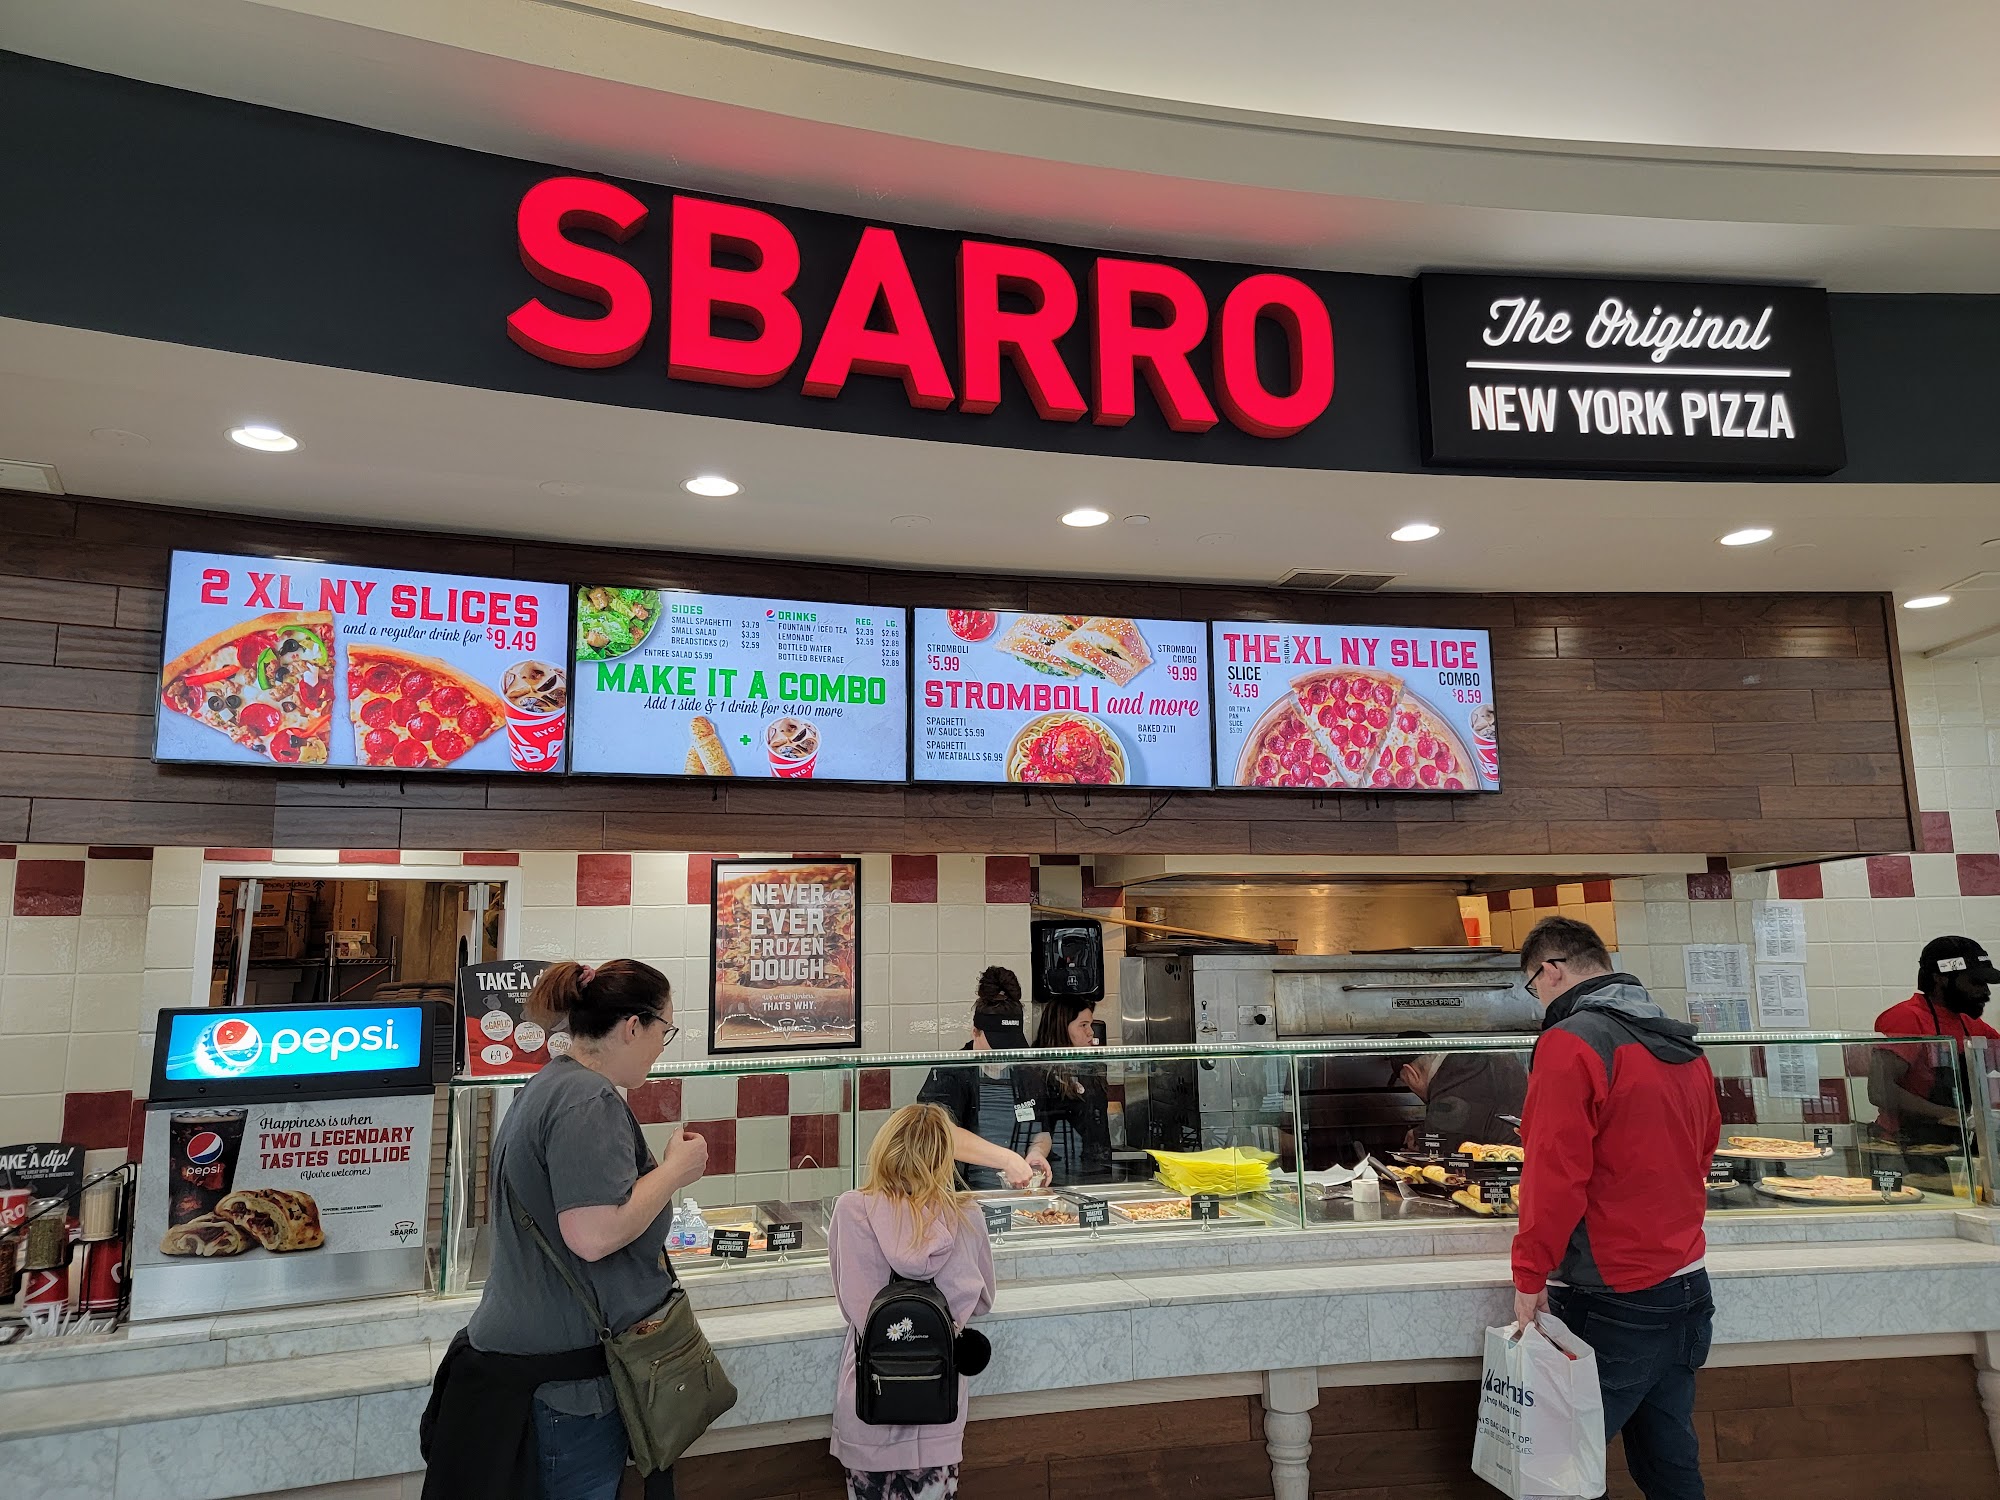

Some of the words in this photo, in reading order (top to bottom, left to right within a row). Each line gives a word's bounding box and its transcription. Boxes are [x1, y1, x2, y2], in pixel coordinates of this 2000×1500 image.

[506, 175, 1335, 438] SBARRO
[1482, 297, 1572, 347] The
[1585, 298, 1773, 363] Original
[1468, 385, 1556, 432] NEW
[1568, 389, 1673, 436] YORK
[1681, 392, 1795, 438] PIZZA
[201, 568, 230, 605] 2
[244, 571, 304, 611] XL
[318, 578, 378, 616] NY
[391, 584, 539, 629] SLICES
[672, 604, 703, 615] SIDES
[778, 611, 817, 622] DRINKS
[671, 616, 694, 625] SMALL
[695, 617, 732, 627] SPAGHETTI
[741, 620, 760, 629] $3.79
[778, 622, 811, 632] FOUNTAIN
[817, 625, 833, 634] ICED
[835, 626, 848, 634] TEA
[855, 627, 874, 636] $2.39
[881, 629, 899, 637] $2.69
[855, 618, 874, 626] REG.
[885, 619, 898, 628] LG.
[343, 623, 366, 635] and
[369, 626, 378, 636] a
[380, 625, 427, 643] regular
[429, 627, 460, 642] drink
[462, 629, 483, 647] for
[486, 627, 537, 652] $9.49
[671, 626, 694, 635] SMALL
[695, 628, 717, 636] SALAD
[741, 630, 760, 639] $3.39
[778, 632, 814, 642] LEMONADE
[855, 637, 874, 646] $2.59
[881, 639, 899, 647] $2.89
[671, 637, 718, 647] BREADSTICKS
[719, 640, 729, 648] (2)
[741, 640, 760, 649] $2.59
[778, 643, 808, 652] BOTTLED
[809, 644, 832, 653] WATER
[881, 649, 899, 657] $2.69
[927, 643, 969, 654] STROMBOLI
[1157, 644, 1197, 654] STROMBOLI
[644, 648, 669, 658] ENTREE
[671, 650, 693, 659] SALAD
[694, 651, 713, 660] $5.99
[1223, 633, 1281, 663] THE
[1283, 635, 1291, 664] ORIGINAL
[1292, 635, 1332, 665] XL
[1341, 637, 1380, 666] NY
[1390, 640, 1478, 669] SLICE
[778, 653, 808, 662] BOTTLED
[809, 654, 845, 664] BEVERAGE
[881, 659, 899, 667] $2.89
[927, 655, 960, 671] $5.99
[1172, 655, 1197, 664] COMBO
[1167, 665, 1197, 681] $9.99
[1228, 665, 1261, 681] SLICE
[1438, 671, 1480, 687] COMBO
[596, 661, 697, 697] MAKE
[707, 668, 738, 698] IT
[747, 670, 769, 700] A
[778, 672, 887, 705] COMBO
[925, 680, 1099, 713] STROMBOLI
[1107, 691, 1143, 715] and
[1149, 697, 1200, 717] more
[1228, 683, 1259, 699] $4.59
[1452, 689, 1482, 704] $8.59
[643, 696, 667, 710] Add
[669, 699, 676, 710] 1
[677, 697, 702, 711] side
[704, 699, 718, 714] &
[719, 701, 725, 712] 1
[728, 701, 759, 714] drink
[760, 702, 780, 719] for
[782, 703, 812, 717] $4.00
[814, 707, 844, 718] more
[926, 717, 967, 726] SPAGHETTI
[1138, 724, 1160, 733] BAKED
[1162, 725, 1176, 734] ZITI
[926, 727, 937, 736] W/
[938, 728, 963, 737] SAUCE
[964, 728, 985, 737] $5.99
[1138, 734, 1157, 743] $7.09
[926, 740, 967, 750] SPAGHETTI
[926, 751, 937, 760] W/
[938, 751, 981, 761] MEATBALLS
[982, 752, 1003, 762] $6.99
[751, 883, 826, 905] NEVER
[751, 908, 826, 935] EVER
[750, 937, 824, 957] FROZEN
[750, 958, 830, 981] DOUGH.
[476, 972, 518, 990] TAKE
[520, 972, 532, 990] A
[762, 1001, 791, 1011] THAT'S
[794, 1001, 817, 1010] WHY.
[487, 1019, 511, 1031] GARLIC
[270, 1019, 395, 1063] pepsi
[259, 1116, 326, 1132] Happiness
[328, 1115, 338, 1127] is
[340, 1114, 373, 1127] when
[259, 1132, 301, 1149] TWO
[311, 1126, 415, 1147] LEGENDARY
[0, 1153, 28, 1171] AKE
[28, 1153, 39, 1168] A
[40, 1147, 75, 1172] dip!
[260, 1150, 328, 1169] TASTES
[337, 1146, 411, 1165] COLLIDE
[186, 1164, 221, 1177] pepsi
[389, 1228, 418, 1237] SBARRO
[716, 1244, 744, 1252] CHEESECAKE
[772, 1238, 796, 1246] CUCUMBER
